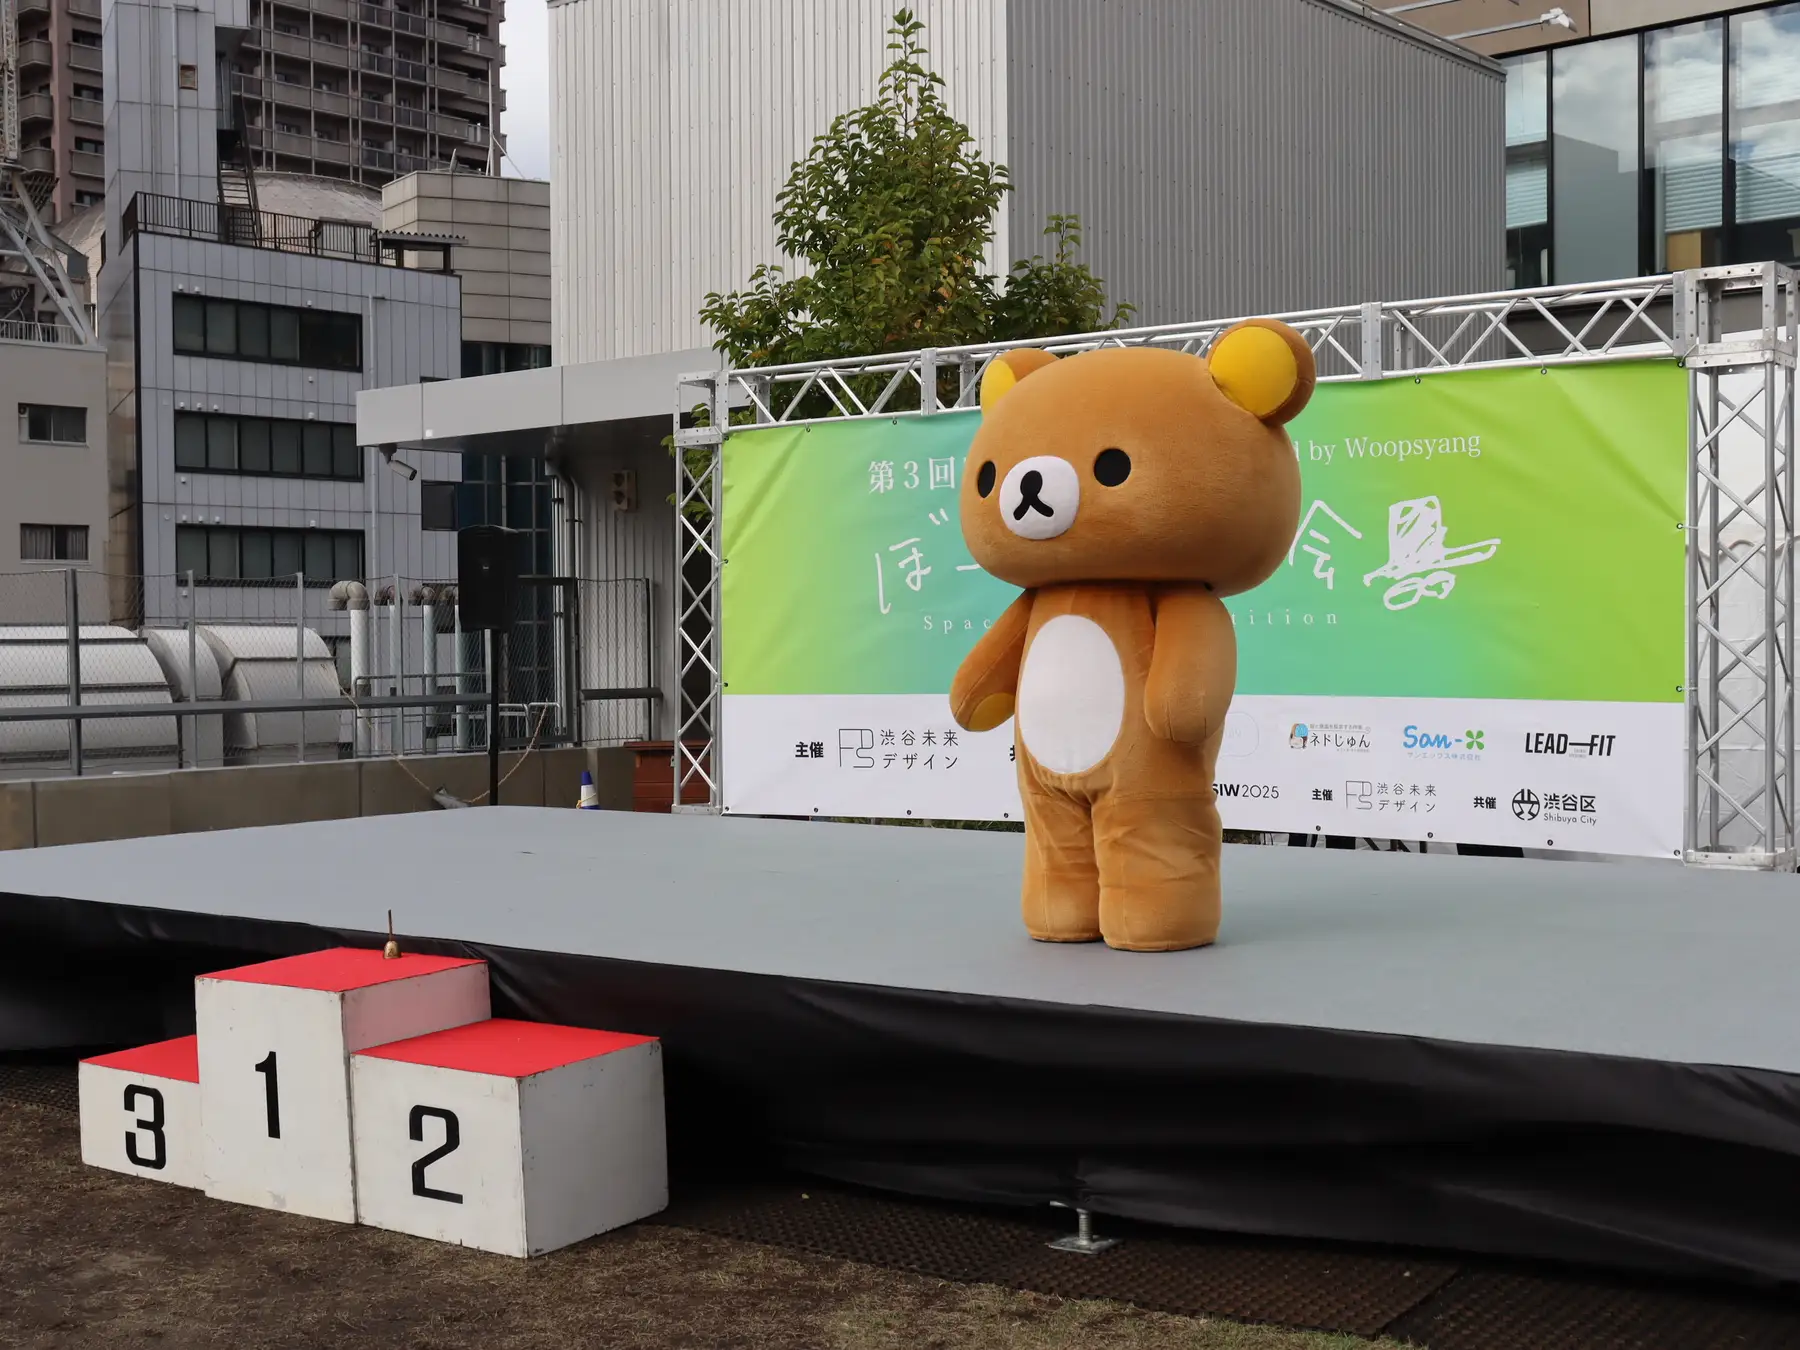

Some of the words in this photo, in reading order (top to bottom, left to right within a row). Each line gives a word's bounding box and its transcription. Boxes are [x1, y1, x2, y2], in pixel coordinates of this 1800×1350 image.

[1308, 439, 1336, 466] by
[1344, 434, 1482, 462] Woopsyang
[923, 615, 993, 635] Spac
[879, 728, 959, 747] 渋谷未来
[1309, 732, 1371, 749] ネドじゅん
[794, 741, 824, 759] 主催
[882, 752, 959, 770] デザイン
[1311, 788, 1334, 802] 主催
[1376, 782, 1437, 798] 渋谷未来
[1378, 799, 1436, 813] デザイン
[1473, 795, 1497, 810] 共催
[1543, 792, 1597, 813] 渋谷区
[1543, 812, 1578, 826] Shibuya
[1580, 814, 1598, 827] City
[254, 1051, 281, 1140] 1
[123, 1083, 167, 1170] 3
[408, 1103, 464, 1205] 2
